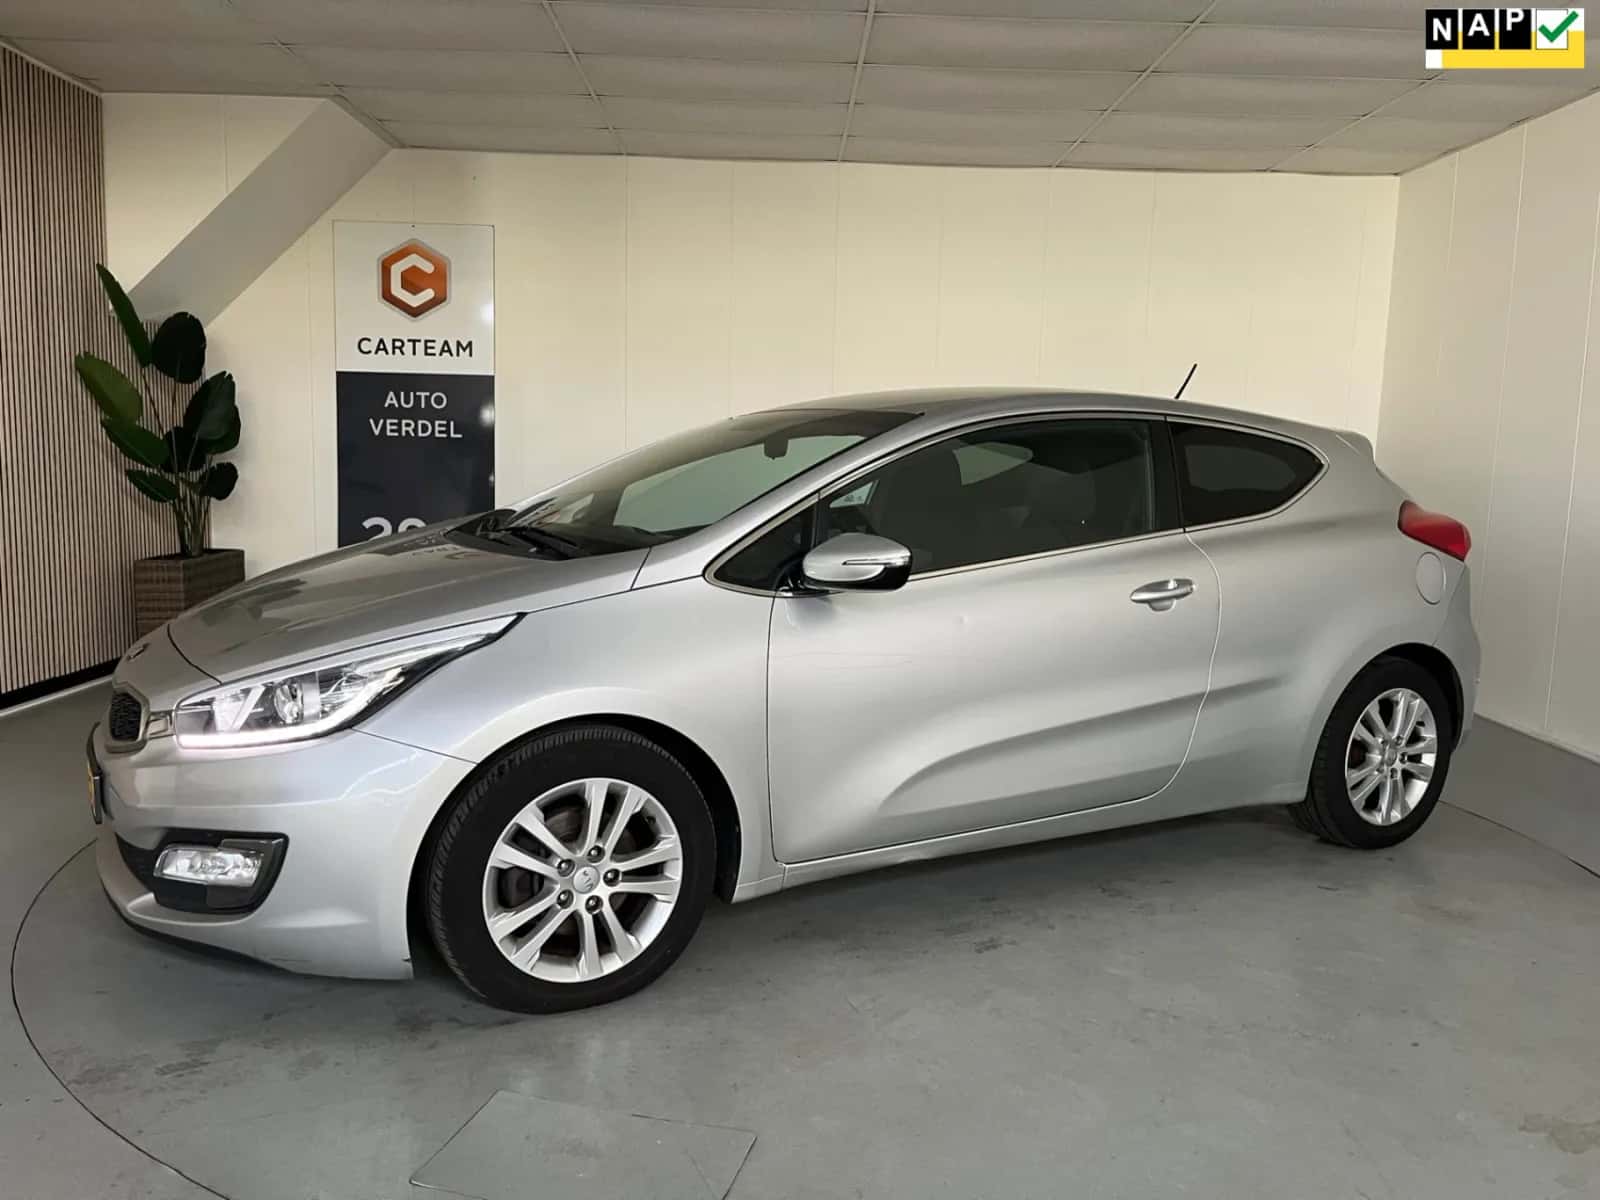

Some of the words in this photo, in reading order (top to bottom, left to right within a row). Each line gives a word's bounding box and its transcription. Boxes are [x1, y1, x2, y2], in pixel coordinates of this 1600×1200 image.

[357, 337, 473, 357] CARTEAM
[384, 392, 447, 408] AUTO
[369, 419, 462, 437] VERDEL
